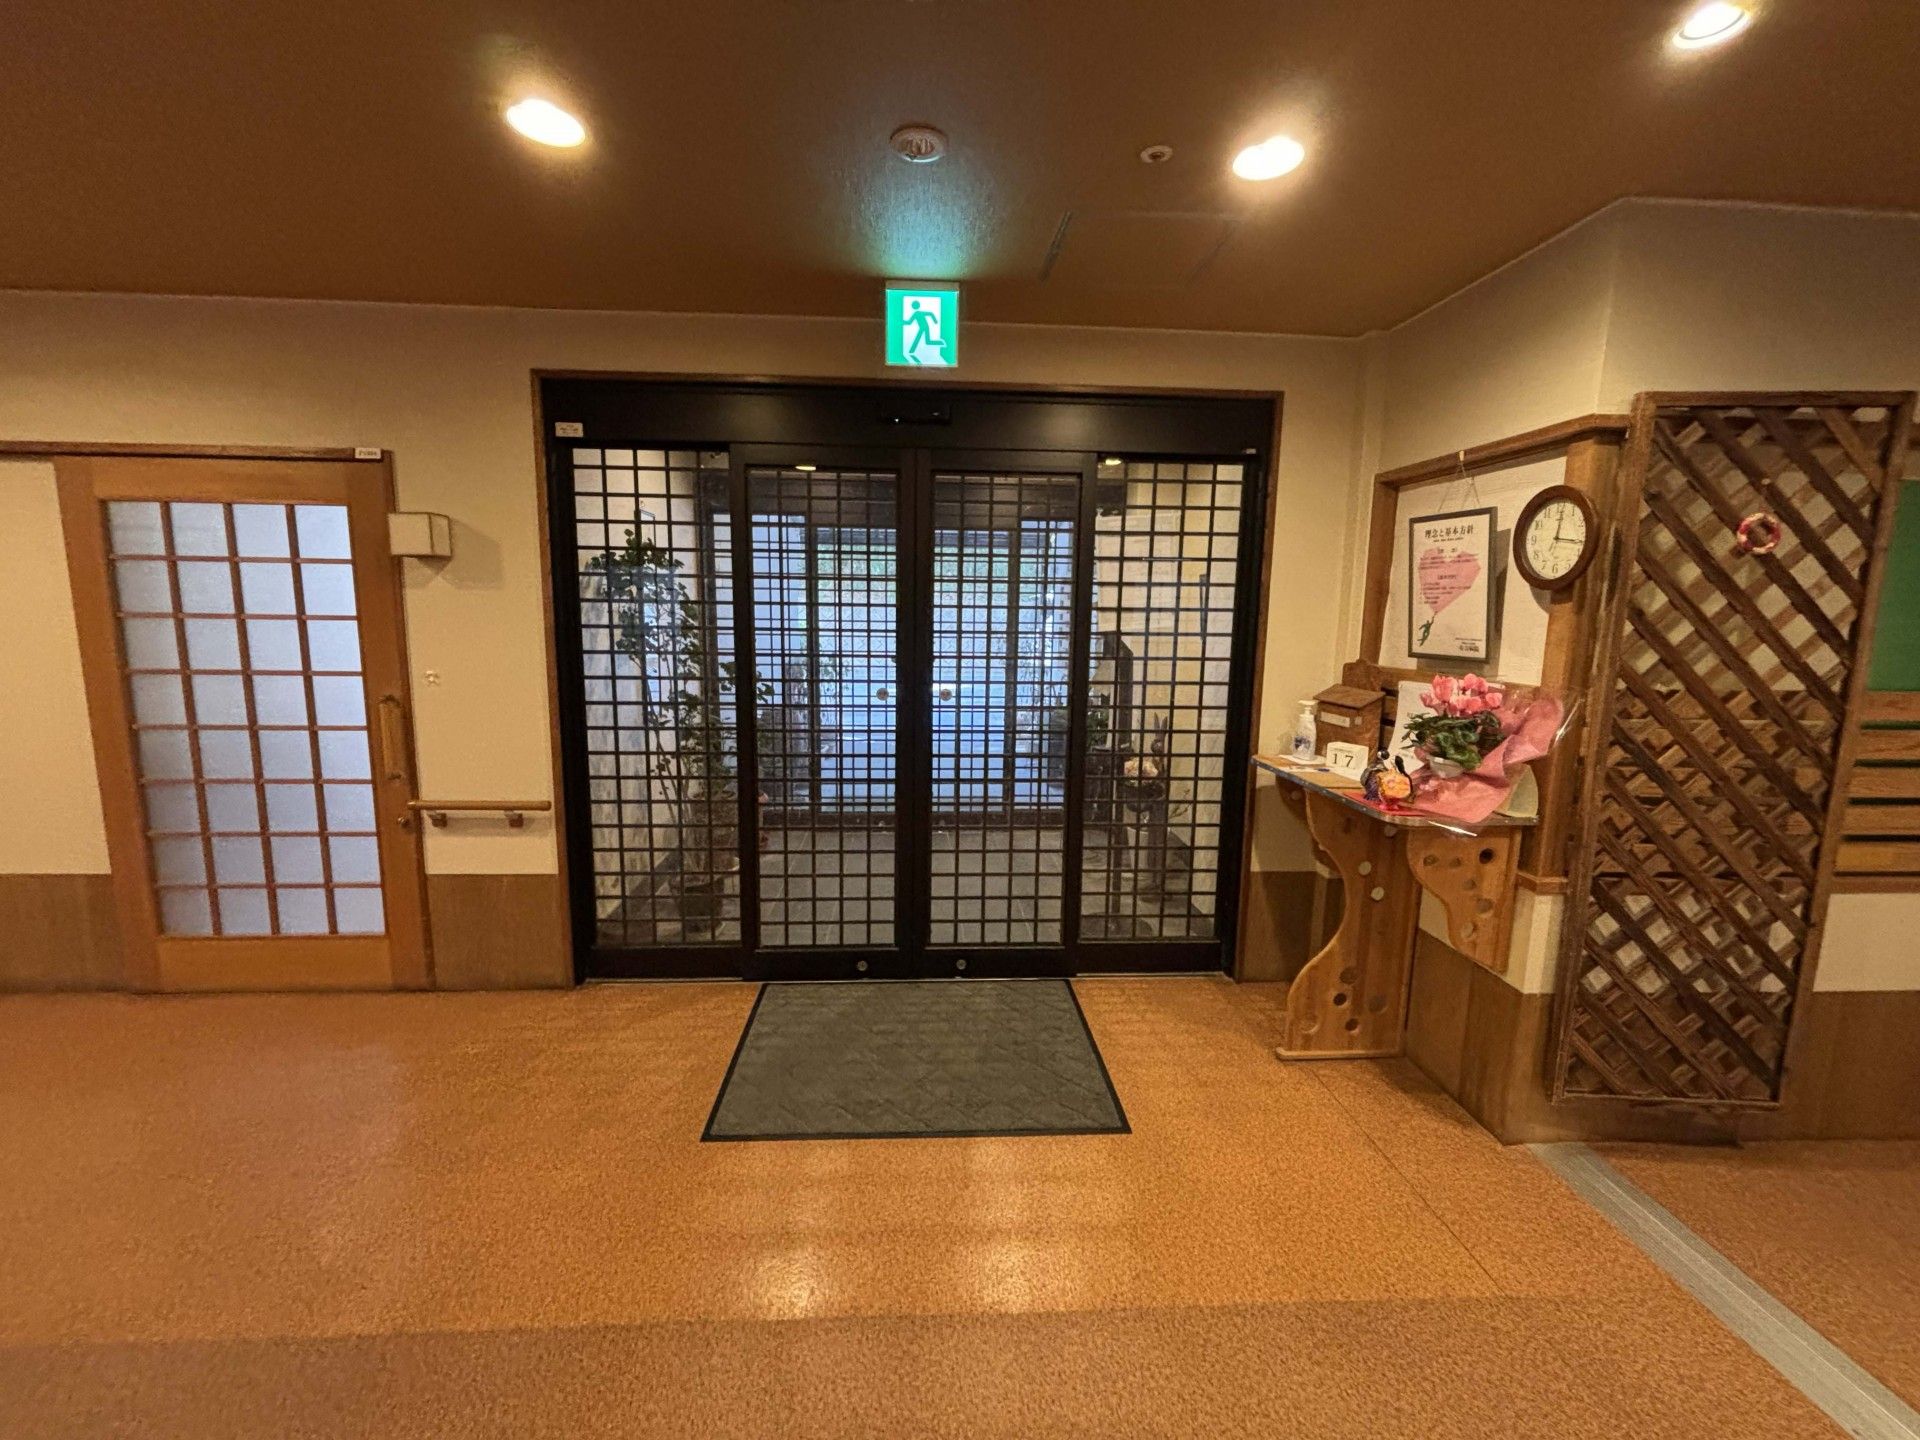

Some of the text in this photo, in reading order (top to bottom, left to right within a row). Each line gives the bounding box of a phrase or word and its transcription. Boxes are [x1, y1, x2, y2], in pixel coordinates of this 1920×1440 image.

[1544, 507, 1551, 519] 11
[1424, 524, 1474, 539] 理念と基本方針
[1551, 562, 1559, 574] 6
